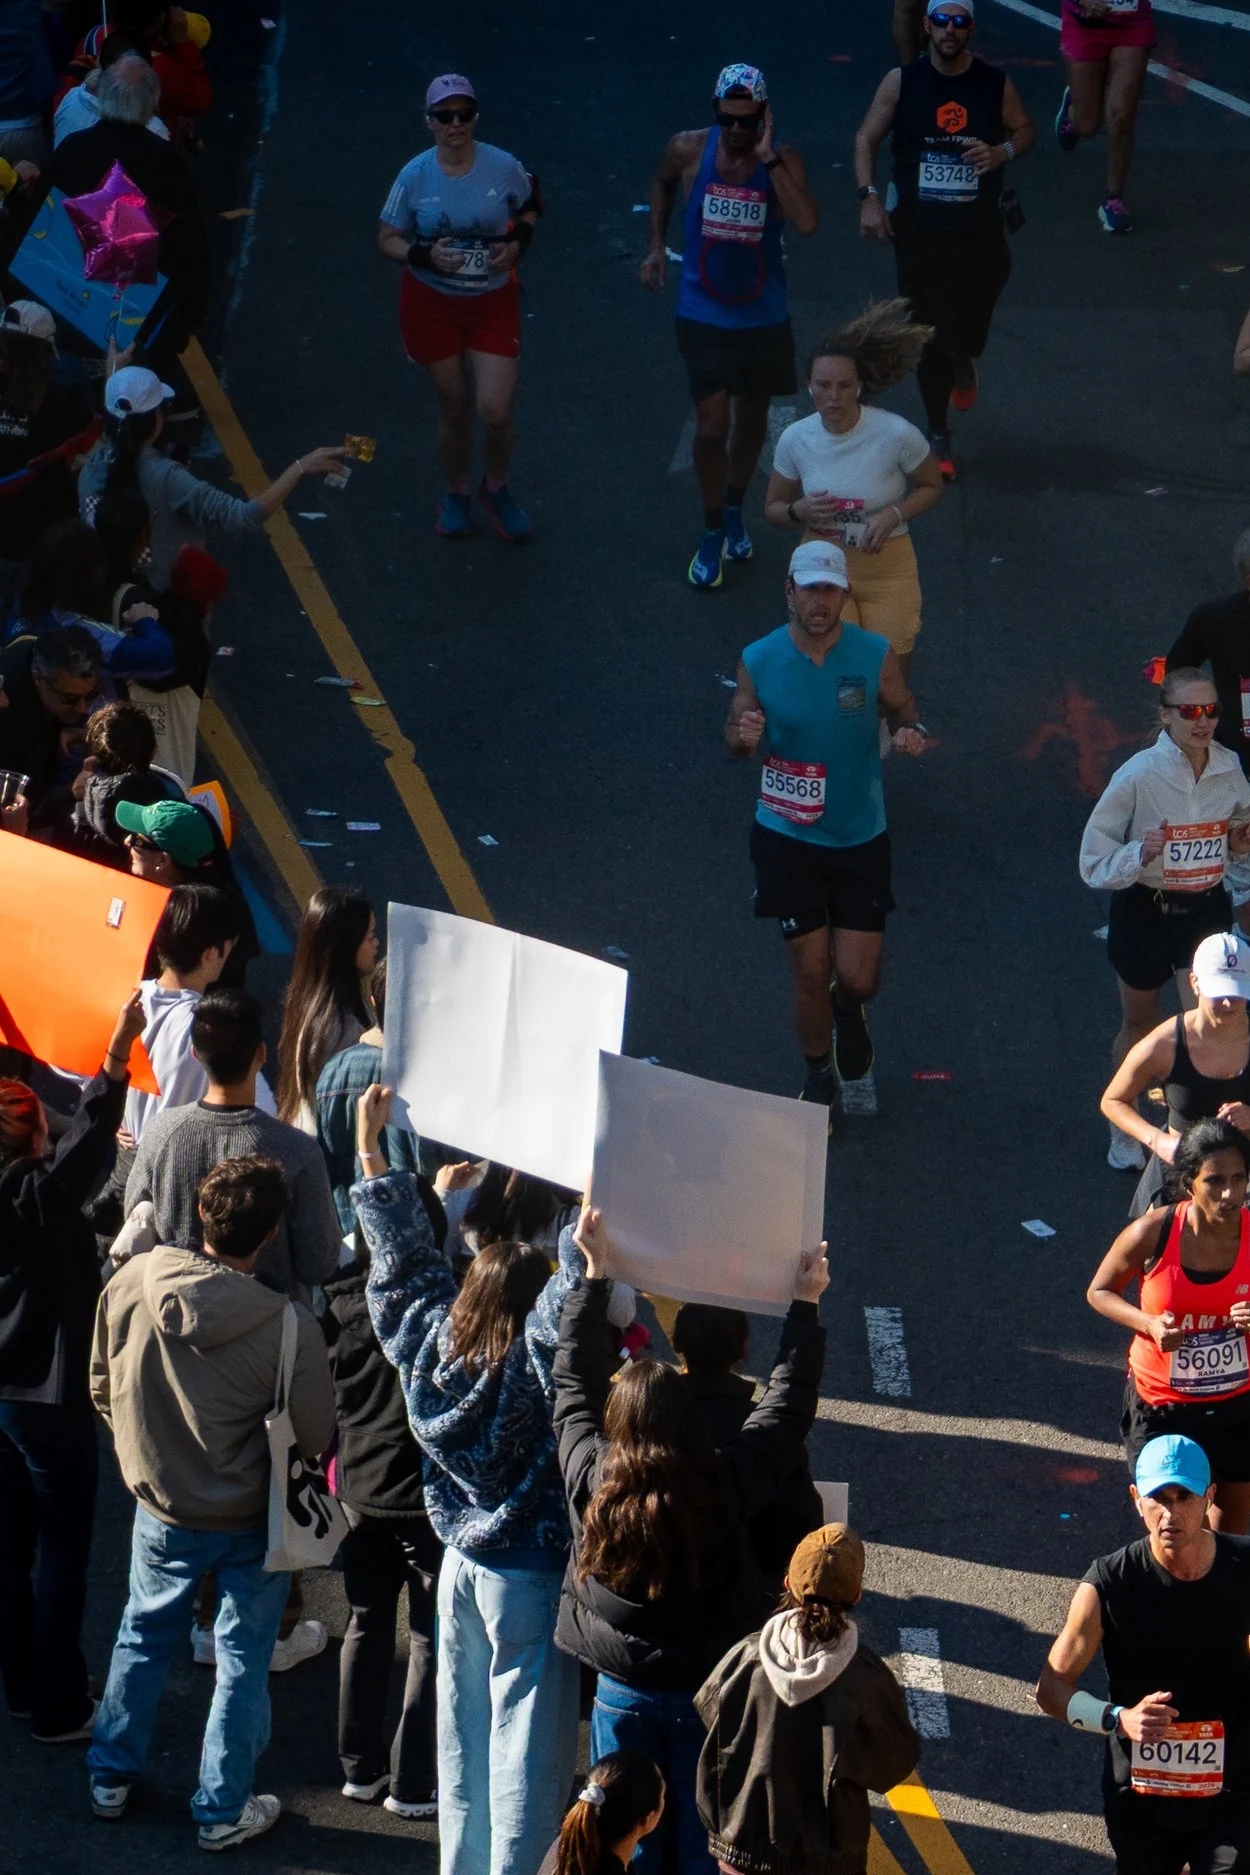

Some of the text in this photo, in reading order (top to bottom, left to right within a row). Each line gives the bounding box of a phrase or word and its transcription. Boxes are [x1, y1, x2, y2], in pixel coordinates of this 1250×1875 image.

[924, 165, 975, 183] 53748
[709, 198, 761, 220] 58518
[765, 768, 821, 799] 55568
[1173, 829, 1188, 839] tcs
[1170, 838, 1222, 862] 57222
[1177, 1341, 1242, 1370] 56091
[1198, 1368, 1225, 1377] RAMYA
[1140, 1742, 1217, 1765] 60142
